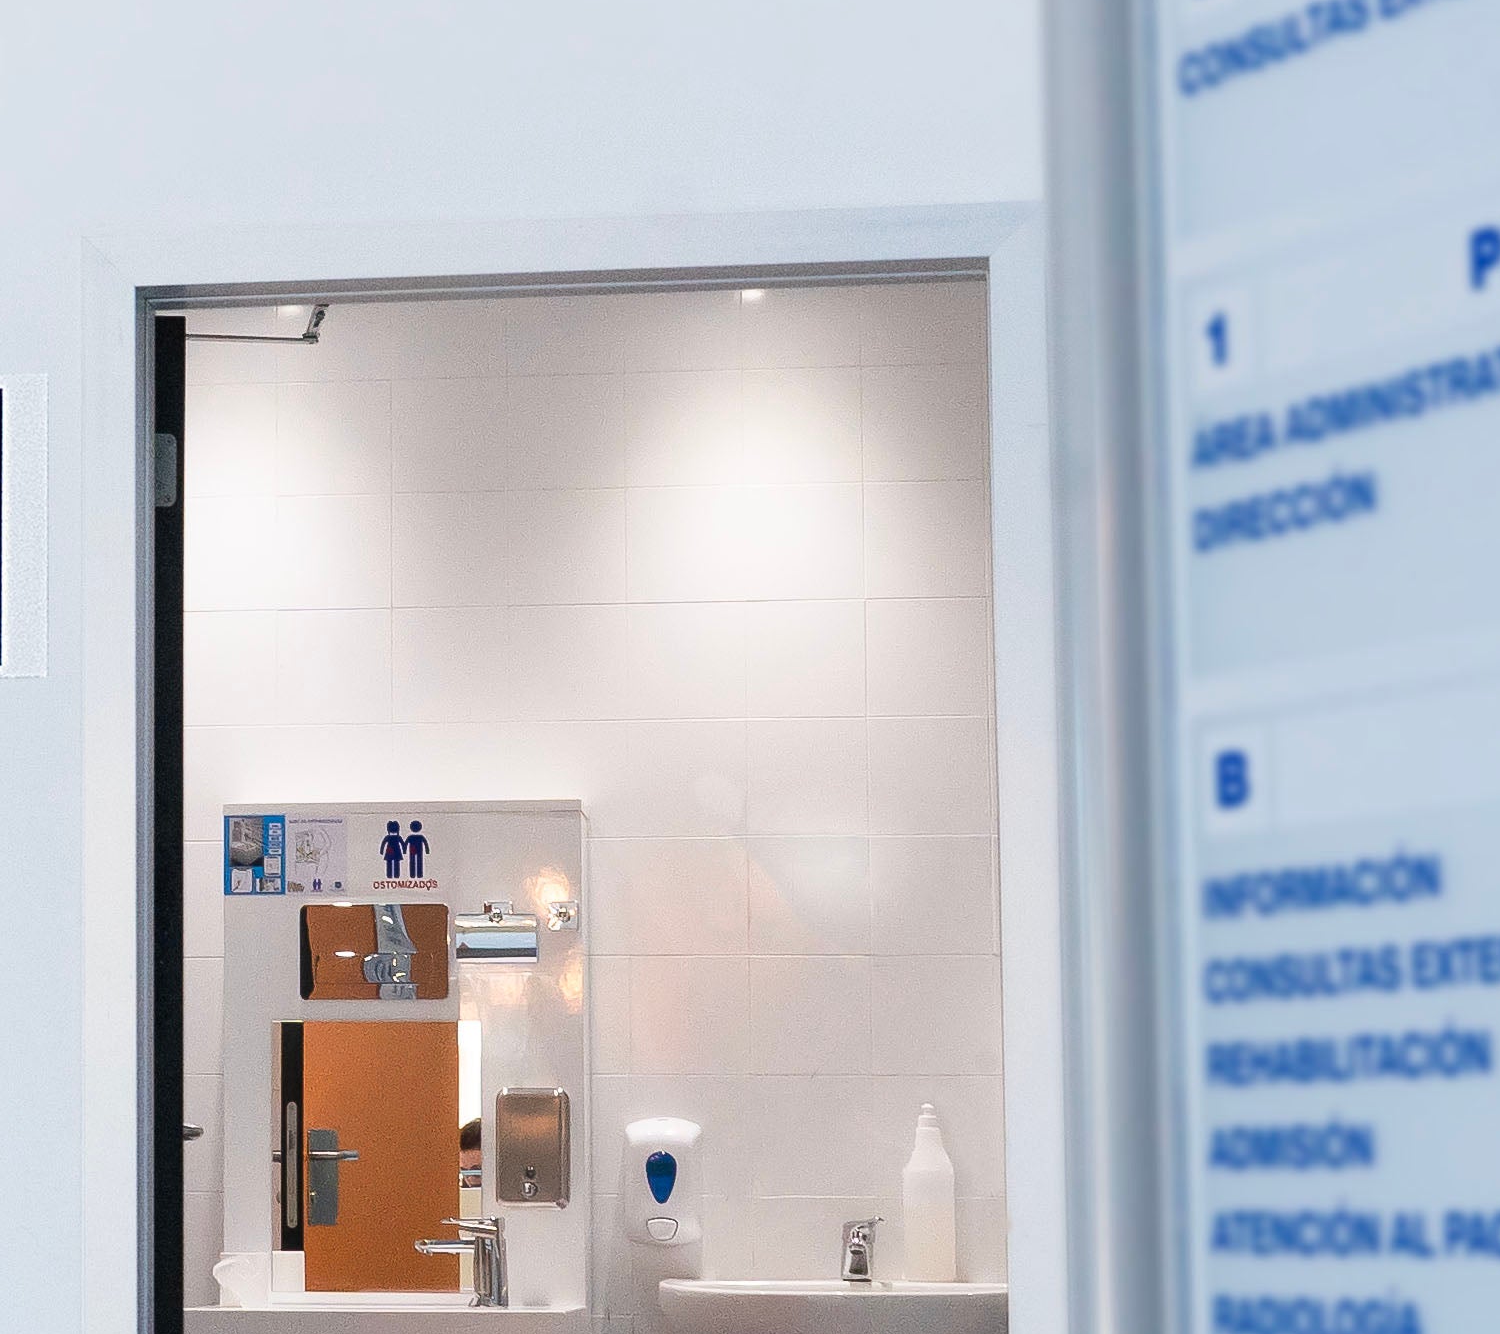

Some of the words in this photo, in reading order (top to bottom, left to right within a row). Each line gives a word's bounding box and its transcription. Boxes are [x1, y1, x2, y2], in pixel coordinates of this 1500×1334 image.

[1205, 312, 1228, 368] 1
[1192, 468, 1377, 554] DIRECCIÓN
[1216, 750, 1250, 809] B
[373, 879, 438, 890] OSTOMIZADOS
[1203, 843, 1443, 919] INFORMACIÓN
[1205, 944, 1400, 1004] CONSULTAS
[1206, 1017, 1493, 1086] REHABILITACIÓN
[1209, 1111, 1374, 1170] ADMISIÓN
[1211, 1197, 1381, 1256] ATENCIÓN
[1391, 1210, 1435, 1259] AL
